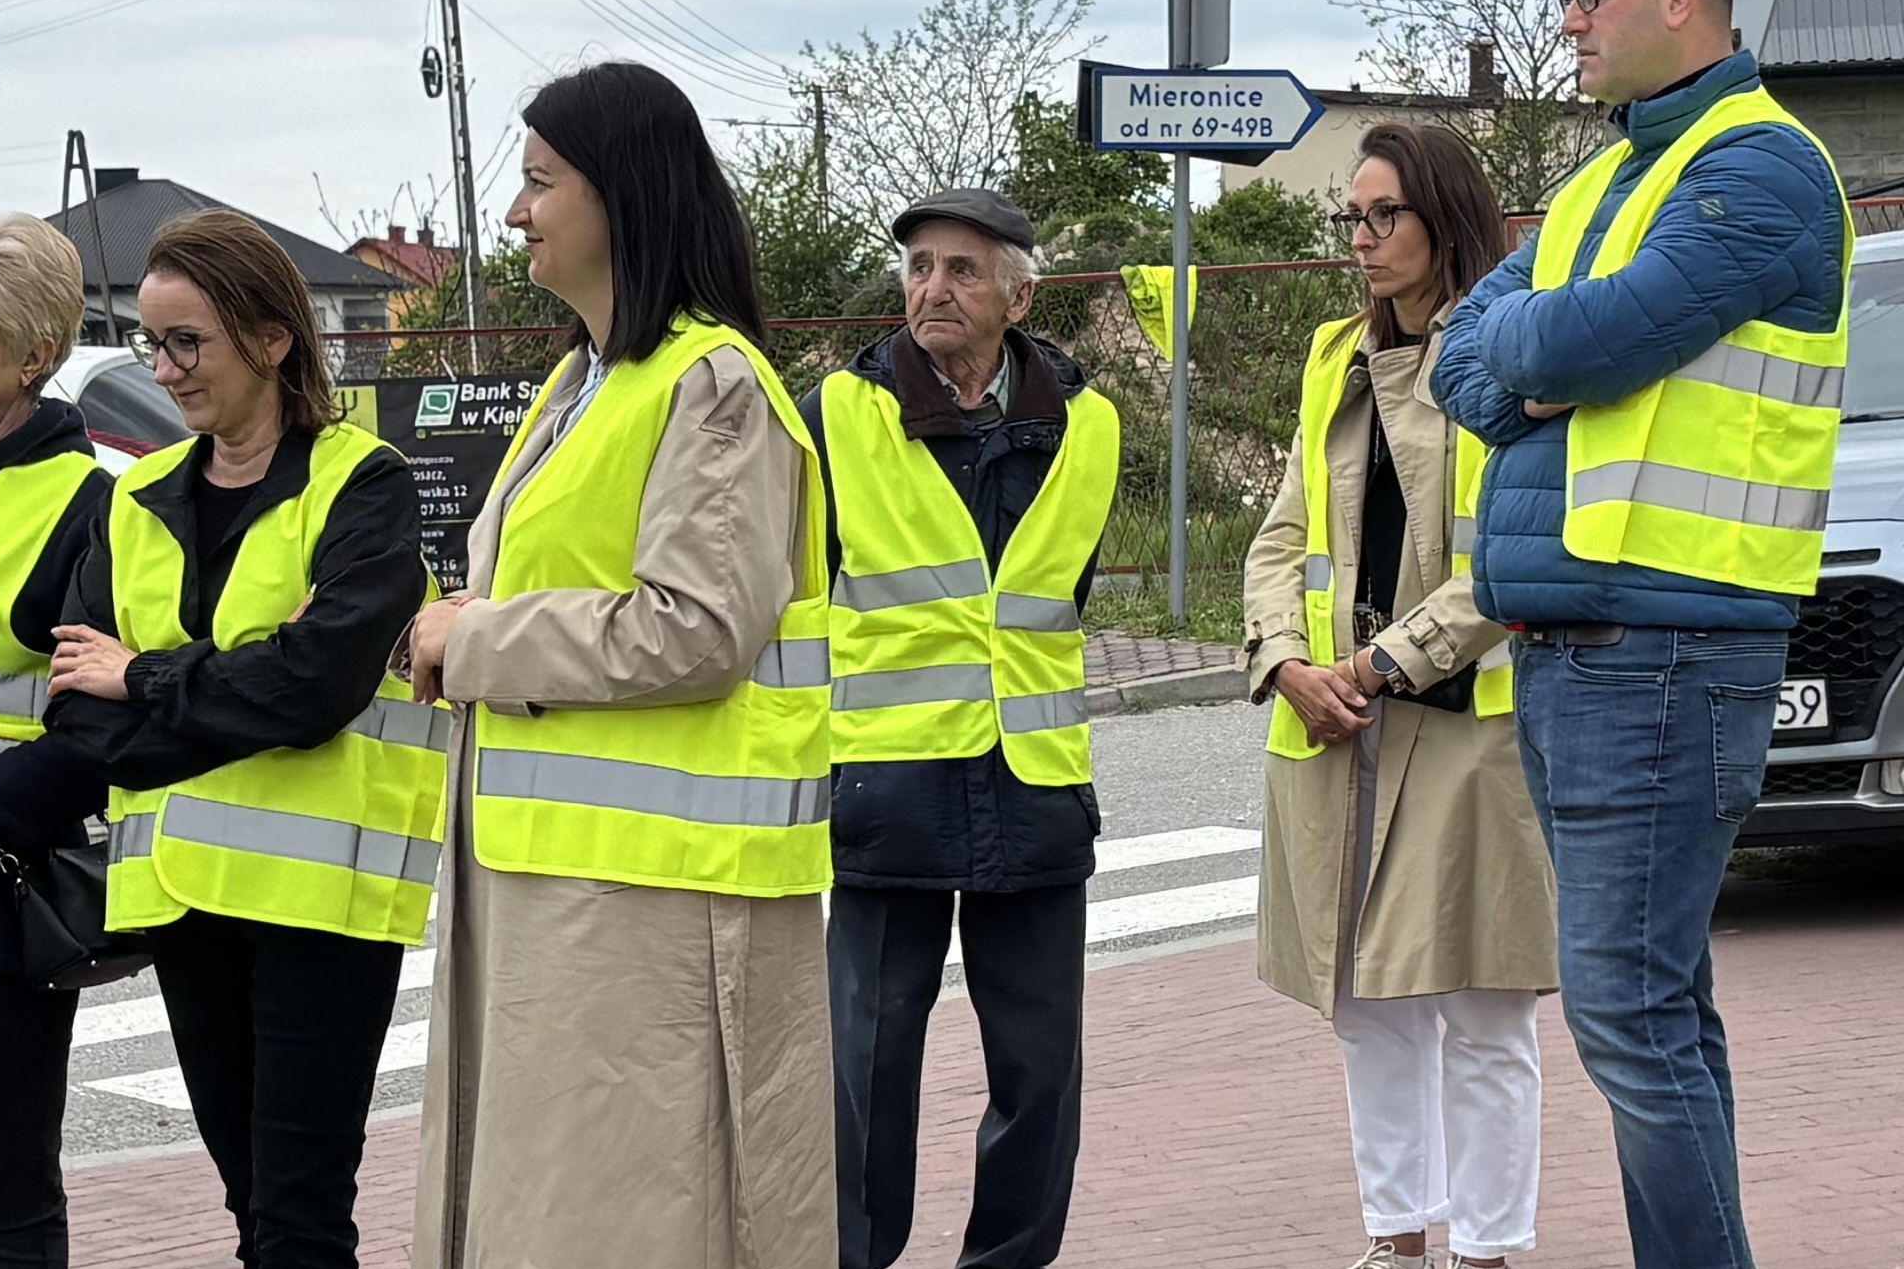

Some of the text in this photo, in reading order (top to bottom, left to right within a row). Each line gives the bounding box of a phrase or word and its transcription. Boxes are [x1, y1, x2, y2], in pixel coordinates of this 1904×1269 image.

[1129, 83, 1263, 107] Mieronice
[1120, 116, 1273, 138] od nr 69-49B
[460, 381, 512, 402] Bank
[461, 411, 479, 426] w
[1777, 685, 1821, 726] 59
